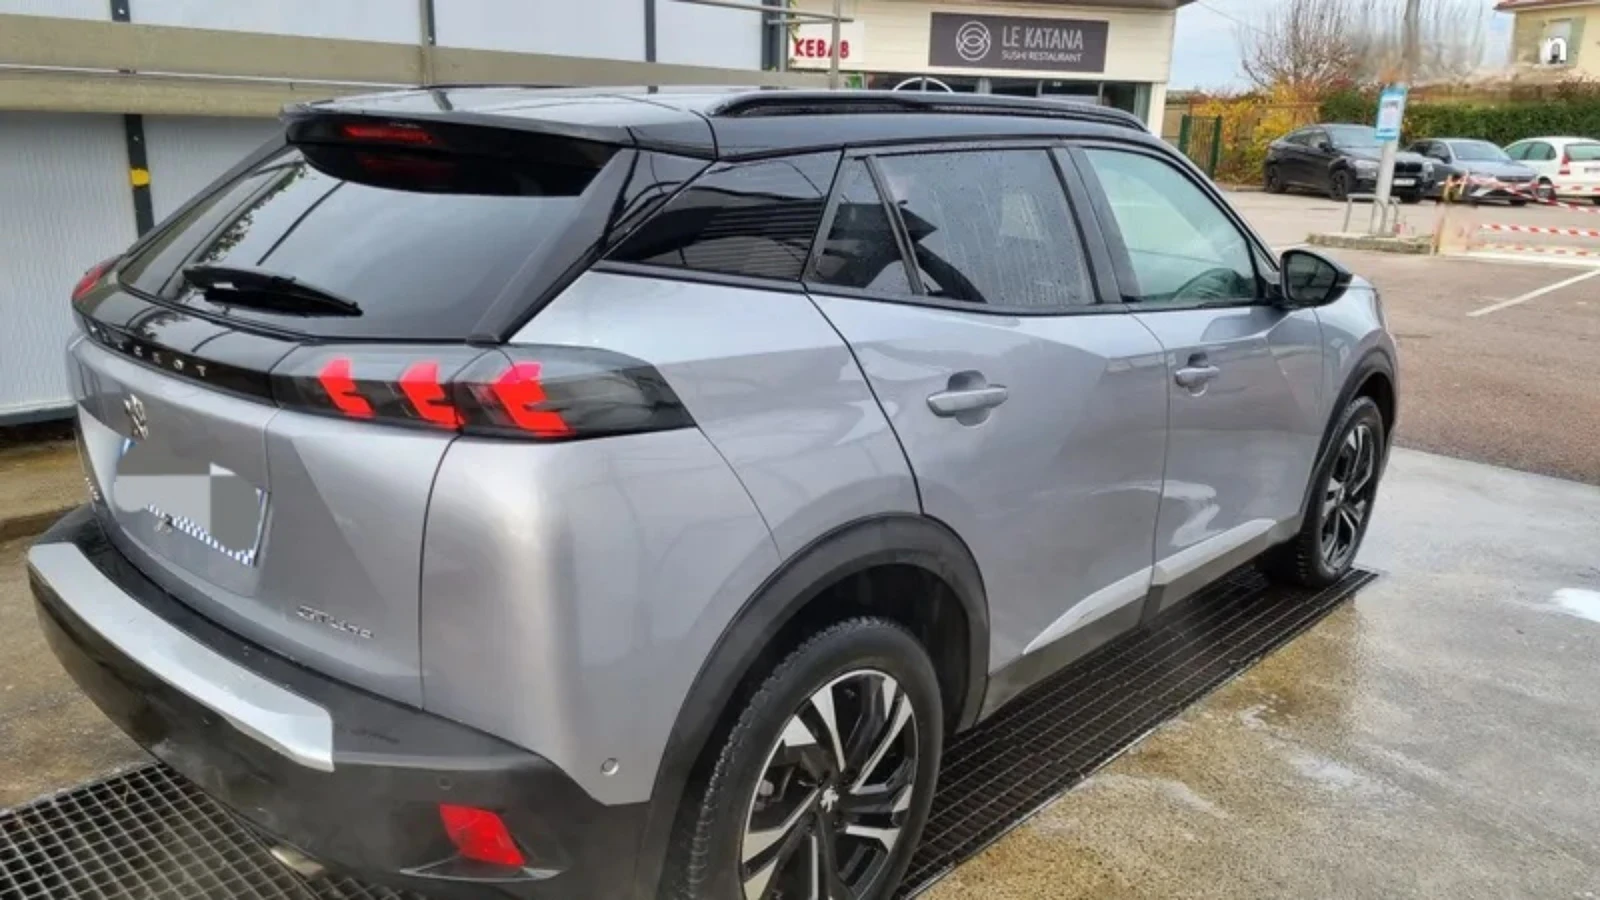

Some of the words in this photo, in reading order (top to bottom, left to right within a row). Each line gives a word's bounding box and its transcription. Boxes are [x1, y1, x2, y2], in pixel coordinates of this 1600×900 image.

[1002, 26, 1020, 47] LE
[1025, 27, 1083, 50] KATANA
[1002, 50, 1027, 61] SUSHI
[1029, 51, 1082, 63] RESTAURANT
